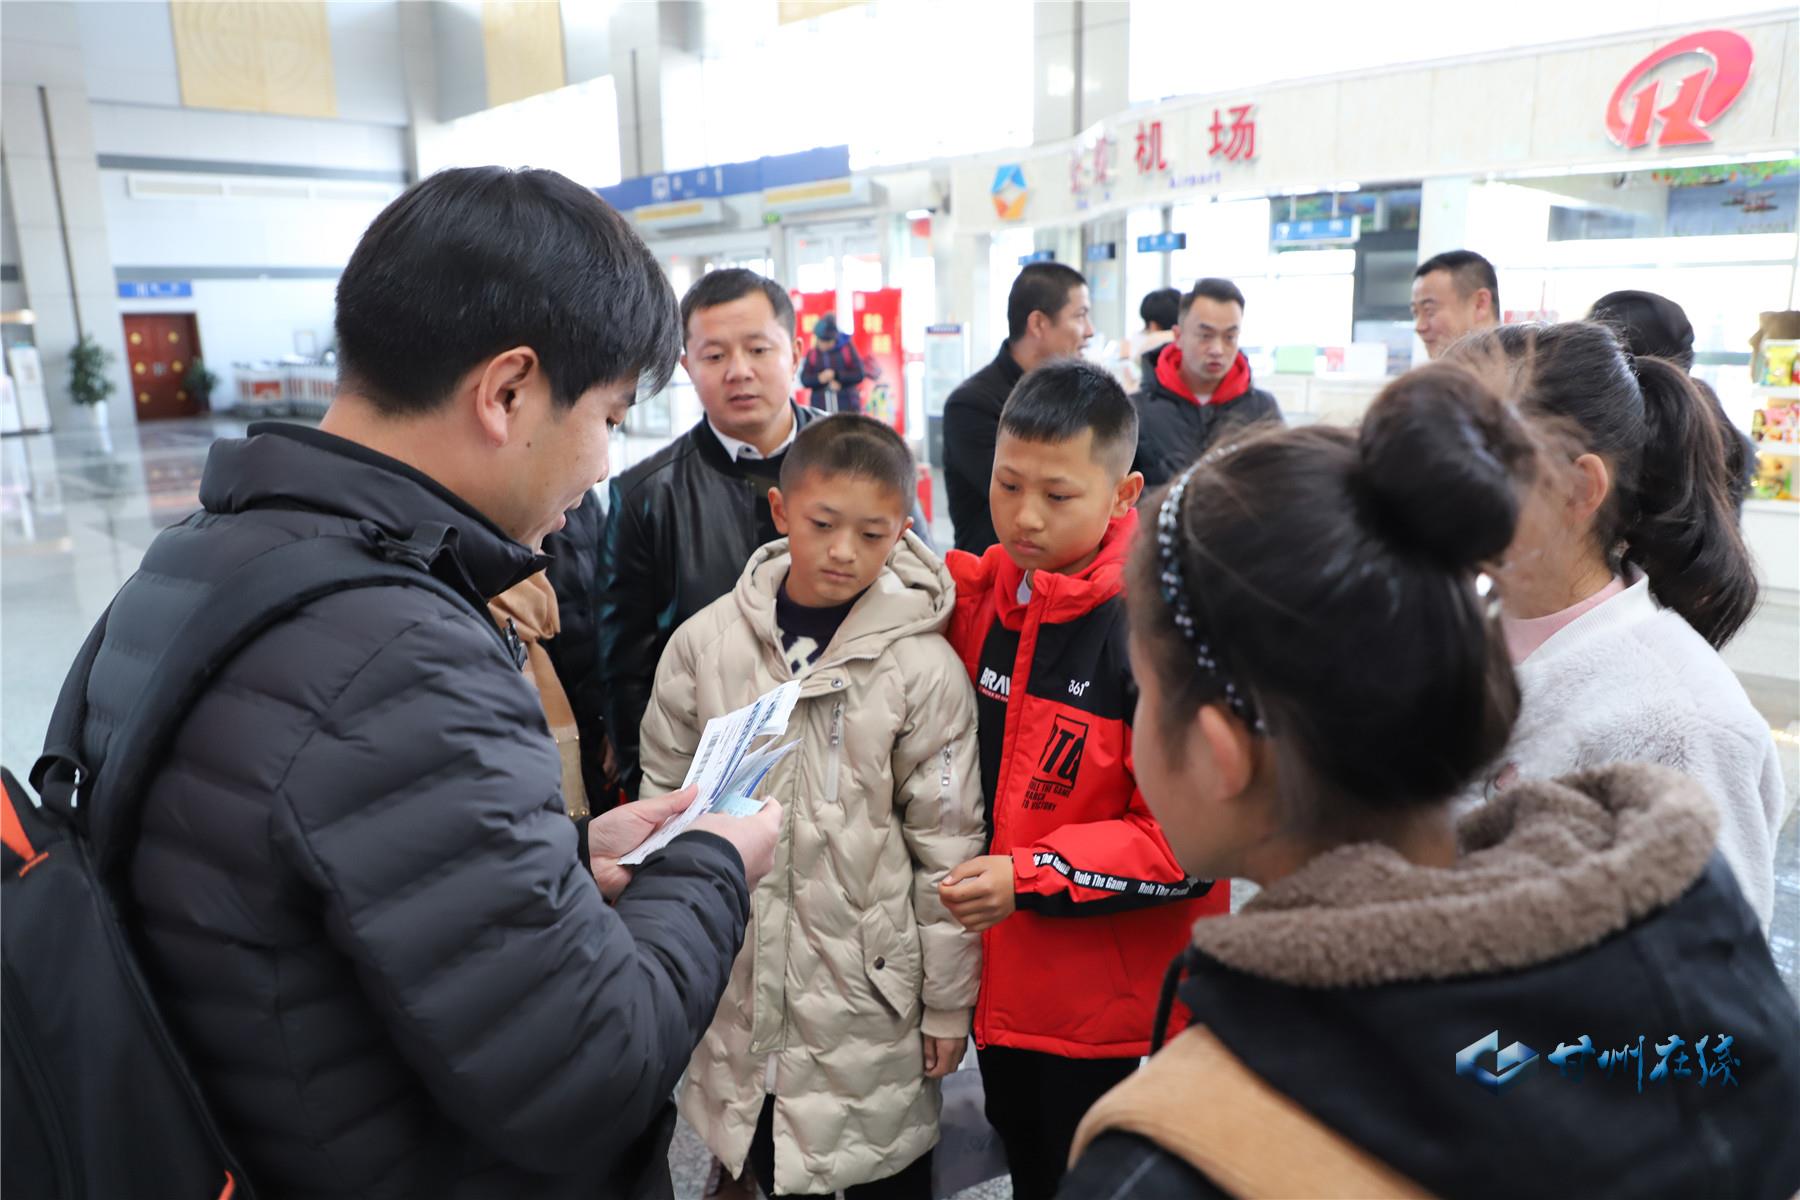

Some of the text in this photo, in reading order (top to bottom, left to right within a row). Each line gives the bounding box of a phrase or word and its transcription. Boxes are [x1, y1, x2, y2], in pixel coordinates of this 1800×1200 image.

[1073, 870, 1128, 892] Rule The Game
[1137, 881, 1156, 895] Rule
[1155, 884, 1169, 897] The
